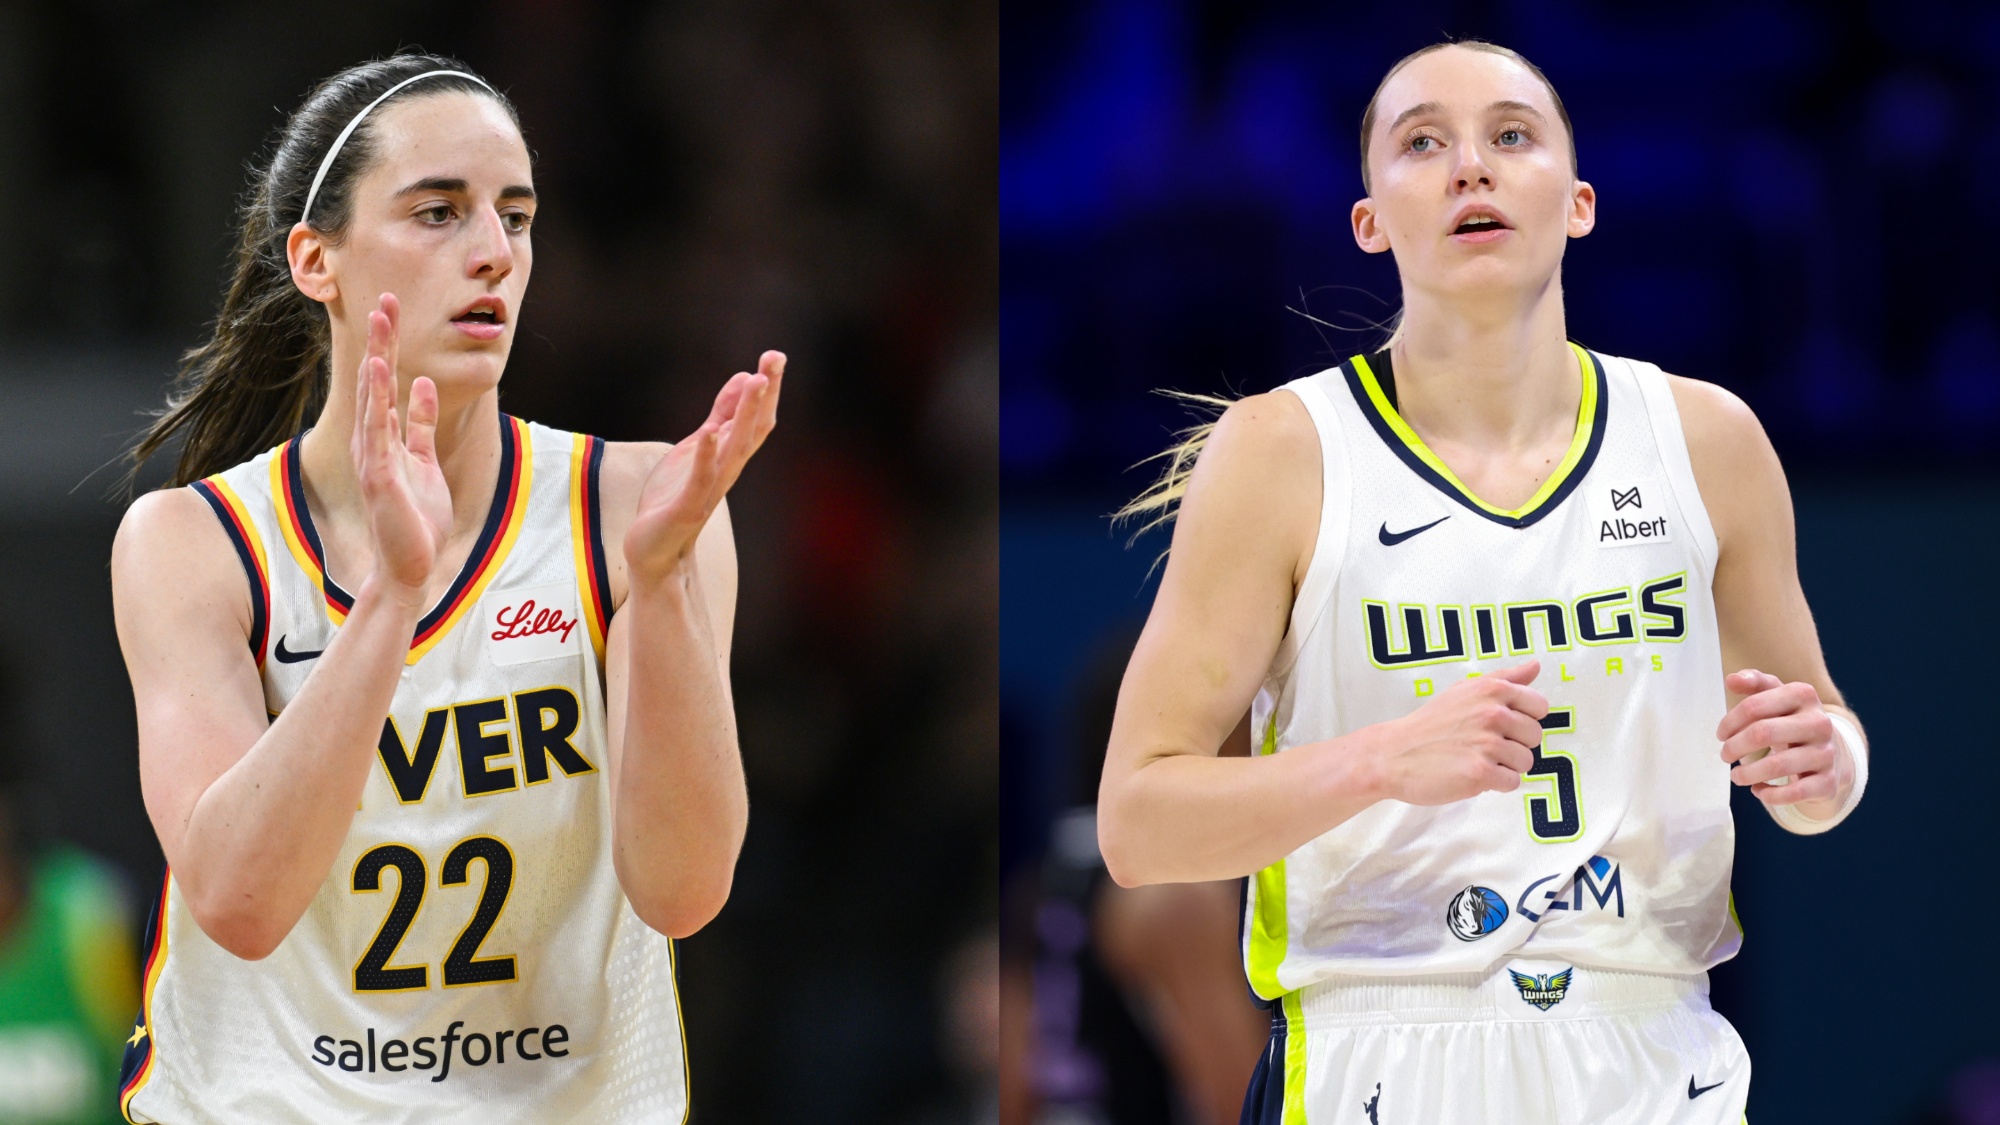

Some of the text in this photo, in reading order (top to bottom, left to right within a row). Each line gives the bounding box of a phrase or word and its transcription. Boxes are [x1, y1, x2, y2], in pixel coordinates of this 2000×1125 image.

[1600, 516, 1666, 542] Albert
[491, 600, 578, 644] Lilly
[1413, 655, 1663, 698] DLAS
[357, 685, 599, 810] VER
[1521, 705, 1585, 844] 5
[350, 834, 519, 994] 22
[311, 1021, 570, 1083] salesforce
